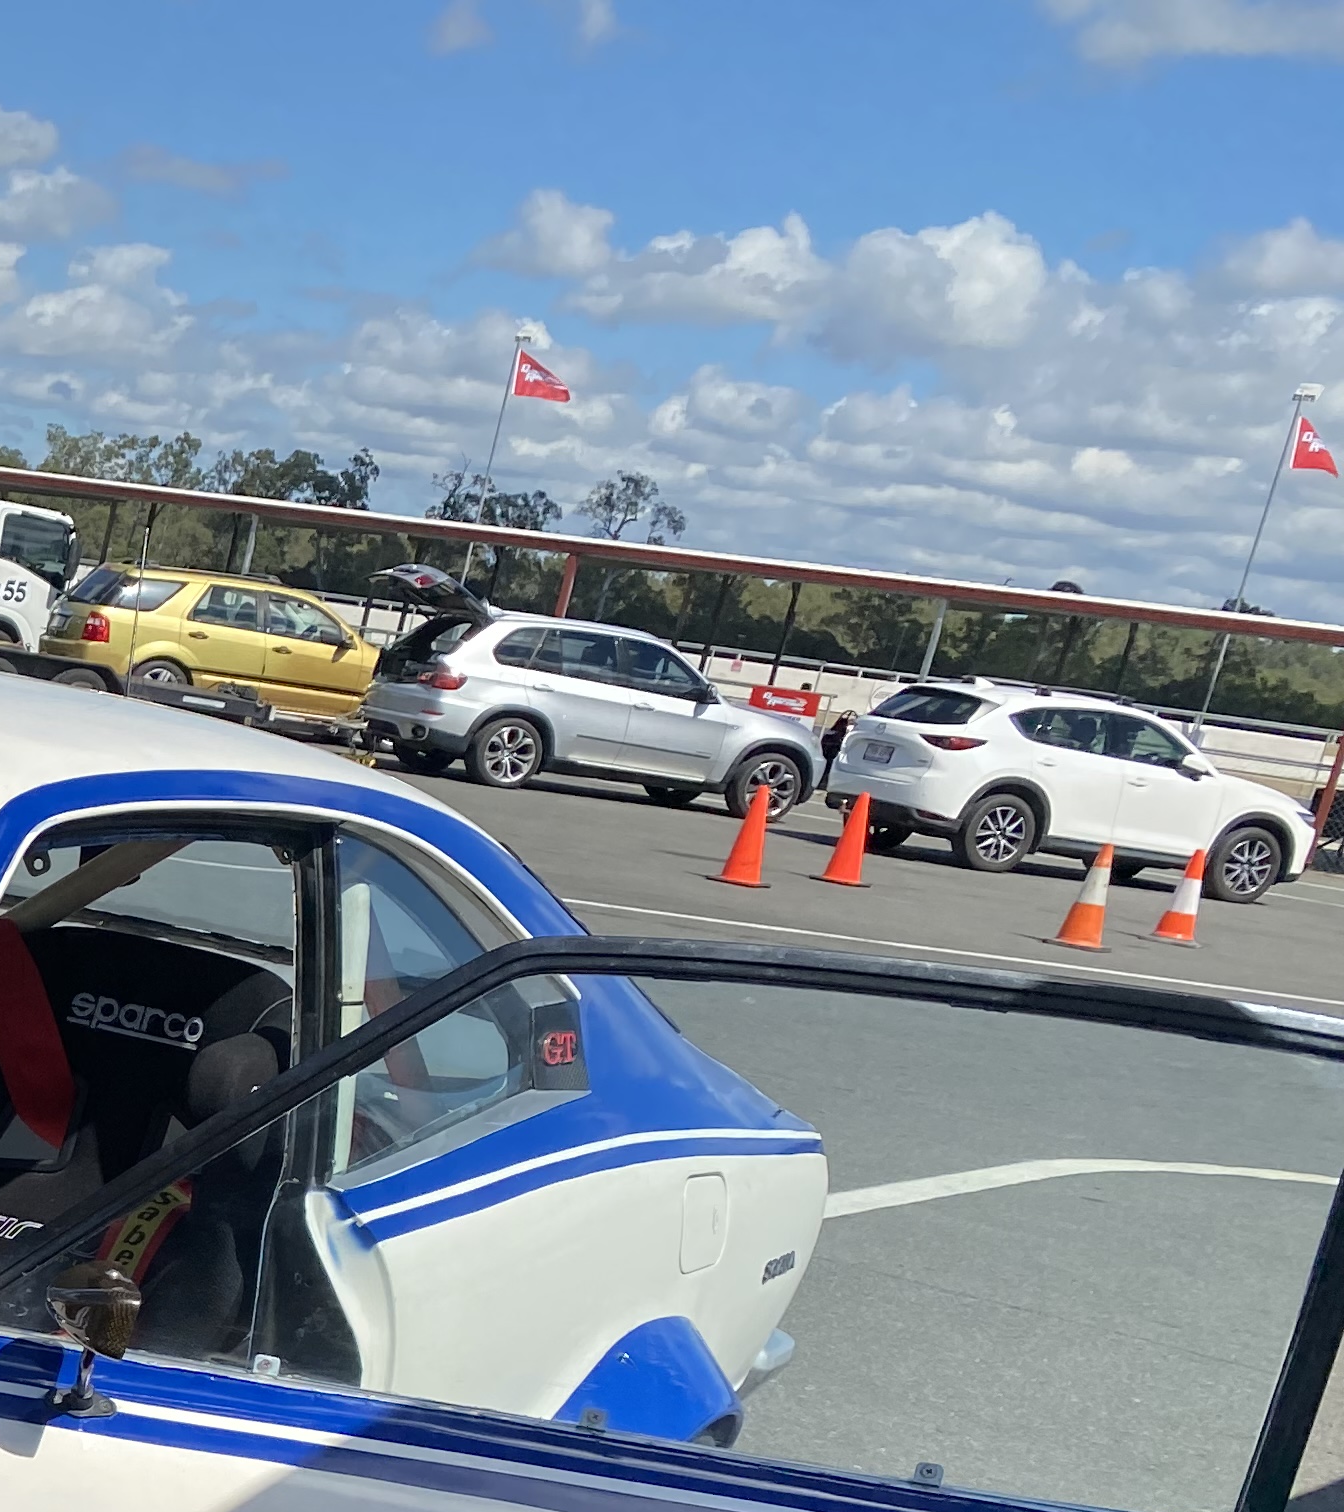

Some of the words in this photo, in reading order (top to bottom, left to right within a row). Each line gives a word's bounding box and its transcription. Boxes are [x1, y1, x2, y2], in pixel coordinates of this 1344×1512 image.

[2, 579, 28, 603] 55
[68, 991, 204, 1043] sparco
[543, 1031, 577, 1065] GT
